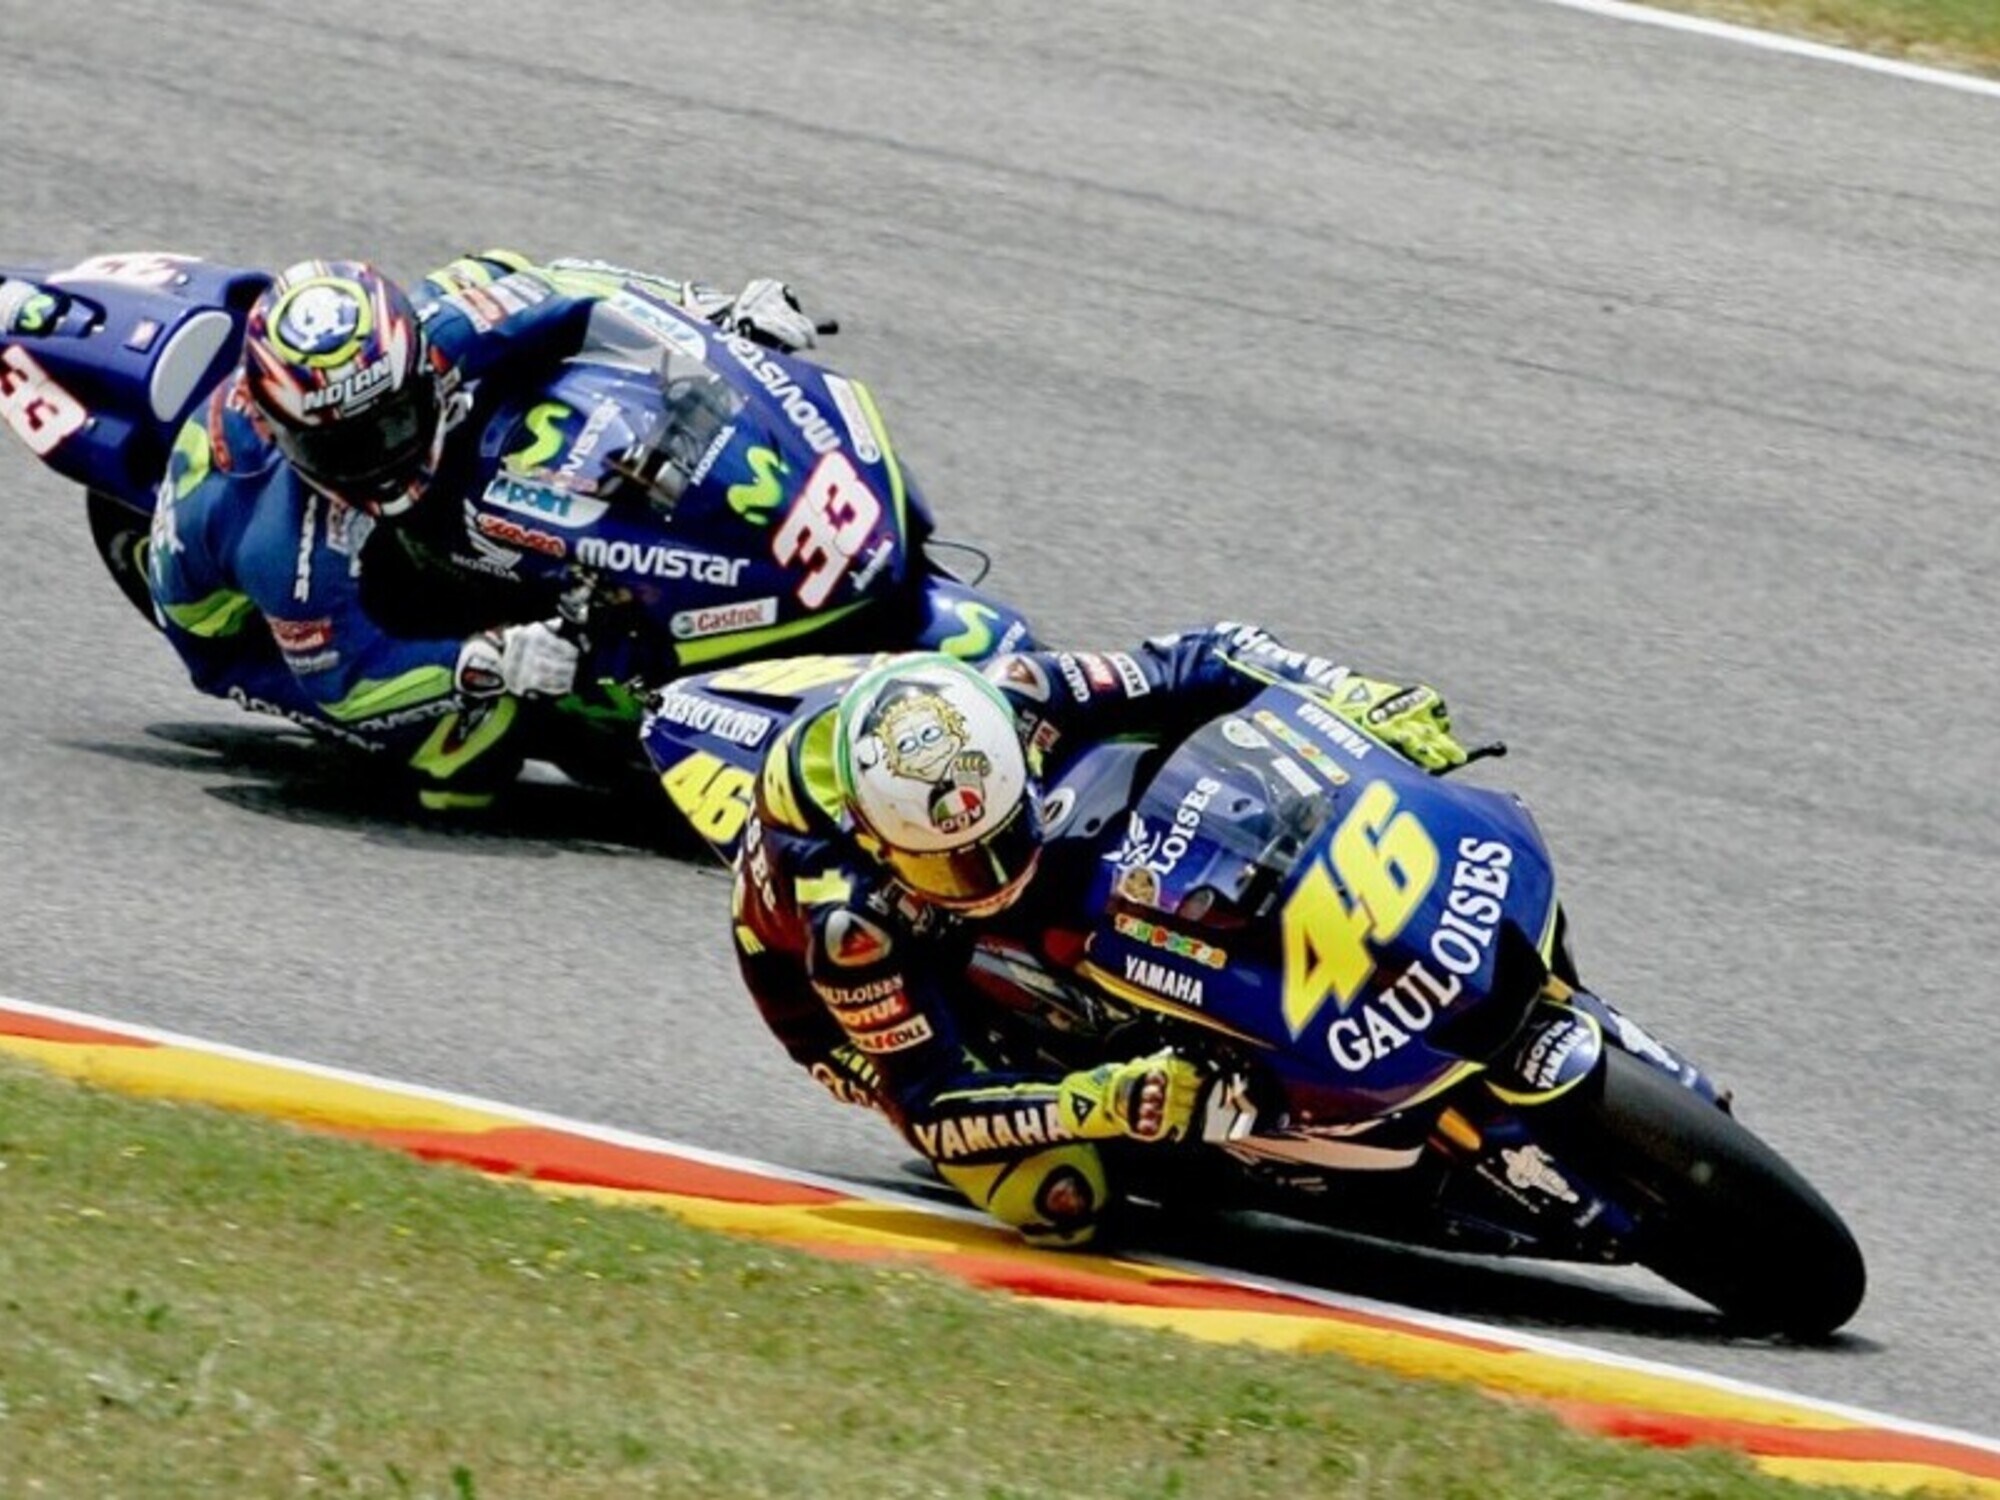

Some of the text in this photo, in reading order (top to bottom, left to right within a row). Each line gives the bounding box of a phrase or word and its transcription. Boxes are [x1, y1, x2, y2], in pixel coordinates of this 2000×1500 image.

[302, 357, 393, 413] NOLAN
[690, 425, 736, 487] HONDA
[773, 450, 882, 610] 33
[575, 537, 751, 587] movistar
[696, 605, 765, 630] Castrol
[1295, 701, 1374, 761] YAMAHA
[661, 750, 758, 845] 46
[1281, 779, 1440, 1043] 46
[1124, 955, 1204, 1006] YAMAHA
[1326, 836, 1513, 1073] GAULOISES
[913, 1103, 1074, 1160] YAMAHA
